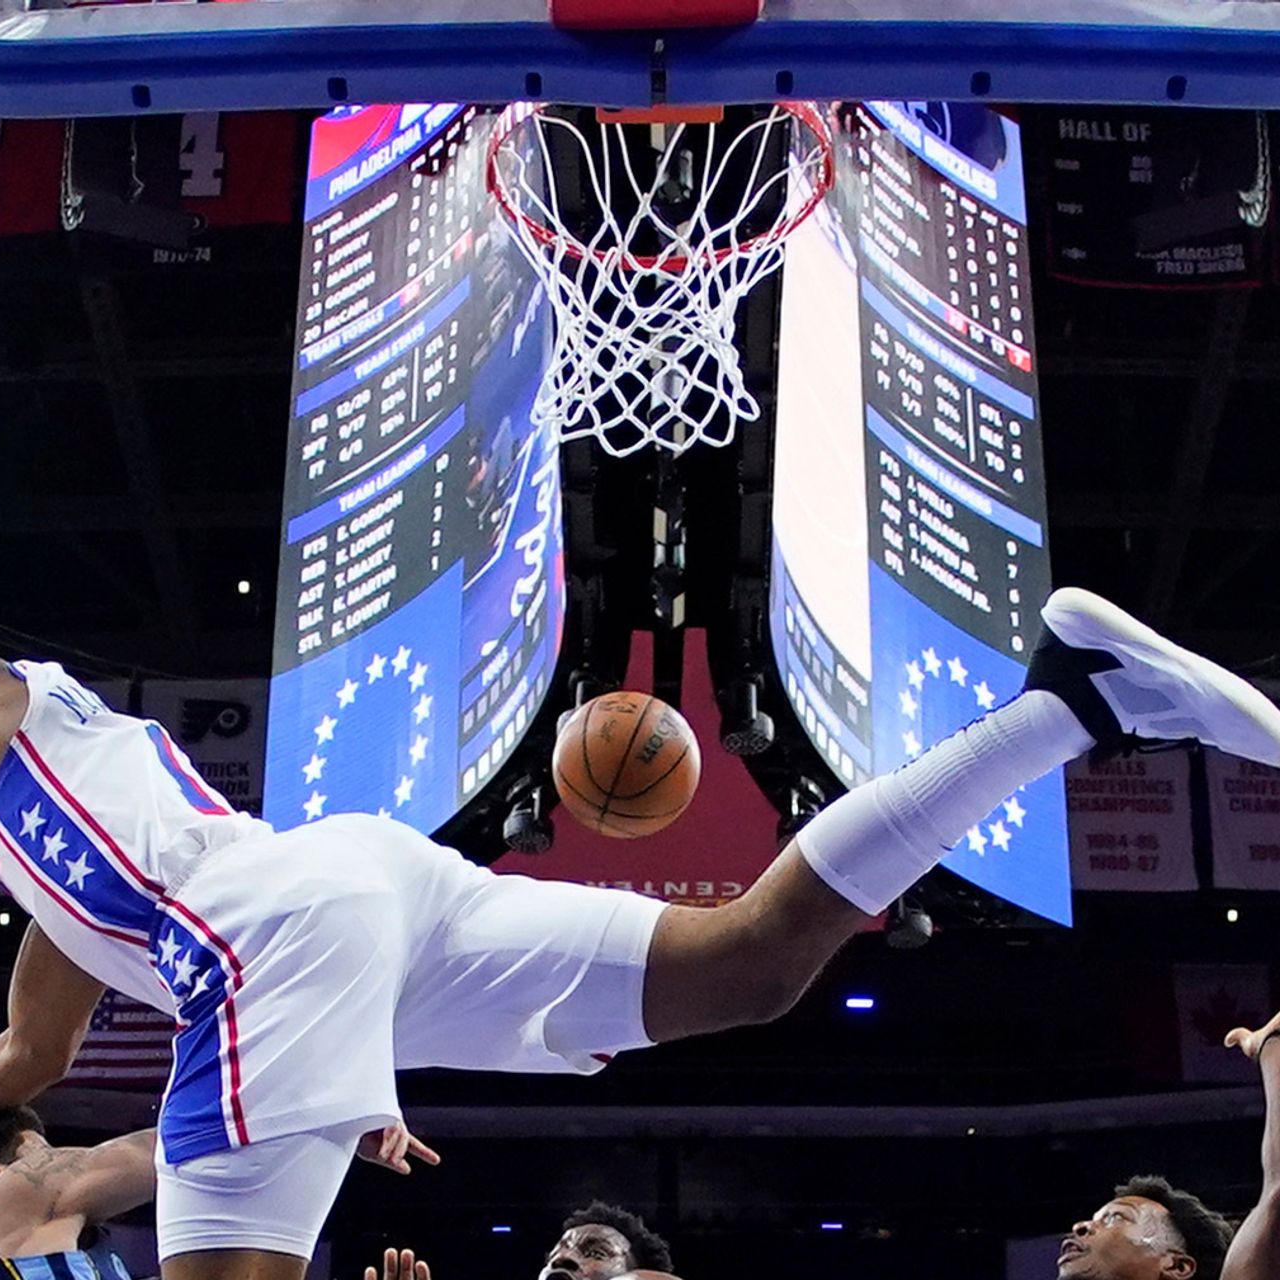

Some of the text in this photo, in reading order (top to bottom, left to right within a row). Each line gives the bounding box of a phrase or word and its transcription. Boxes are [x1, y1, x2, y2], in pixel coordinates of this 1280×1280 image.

[1058, 118, 1152, 142] HALL OF
[179, 110, 224, 197] 4
[328, 122, 422, 201] PHILADELPHIA
[354, 347, 390, 380] TEAM
[1008, 420, 1022, 437] 0
[984, 450, 1025, 484] TO 4
[1010, 443, 1023, 461] 2
[338, 479, 376, 513] TEAM
[301, 534, 328, 561] PTS
[349, 489, 404, 534] GORDON
[349, 517, 396, 559] LOWRY
[1007, 563, 1019, 580] 7
[297, 581, 326, 609] AST
[297, 605, 325, 632] BLK
[346, 564, 398, 607] MARTIN
[920, 554, 974, 603] JACKSON
[1010, 610, 1020, 628] 1
[297, 630, 323, 655] STL
[345, 590, 392, 631] LOWRY
[1010, 634, 1024, 653] 0
